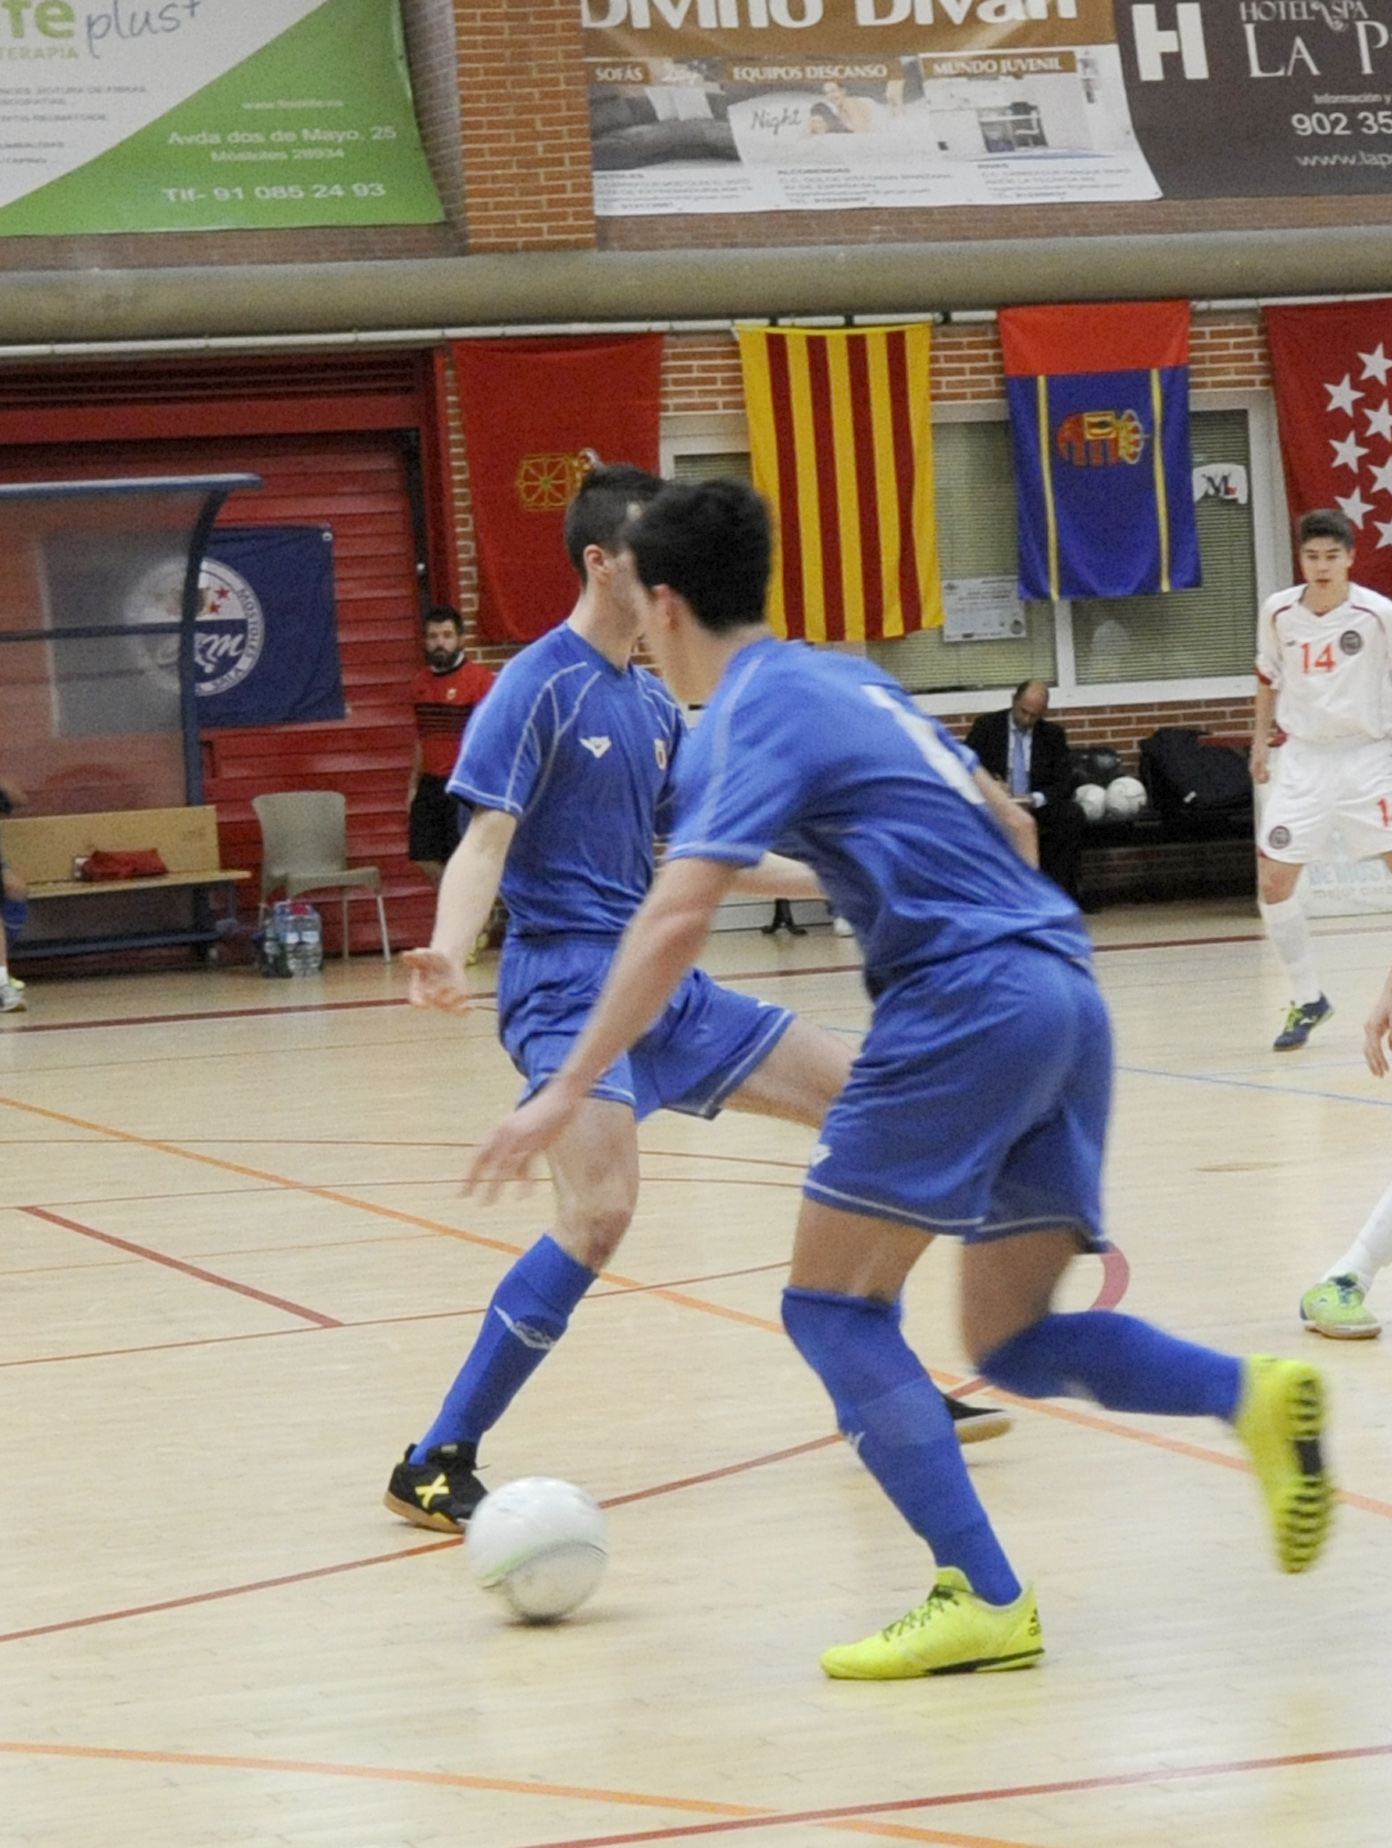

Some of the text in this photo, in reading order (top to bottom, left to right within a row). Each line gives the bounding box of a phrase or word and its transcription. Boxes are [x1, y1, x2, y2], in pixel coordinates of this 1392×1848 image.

[1239, 1, 1316, 21] HOTEL
[1131, 2, 1209, 82] H
[732, 65, 802, 82] EQUIPOS
[805, 64, 888, 80] DESCANSO
[932, 60, 997, 76] MUNDO
[1000, 57, 1062, 74] JUVENIL
[227, 130, 265, 143] dos
[270, 129, 297, 142] de
[371, 125, 398, 140] 25
[1291, 111, 1352, 136] 902
[213, 186, 244, 200] 91
[254, 184, 305, 199] 085
[312, 183, 345, 198] 24
[351, 182, 387, 197] 93
[1301, 641, 1336, 674] 14
